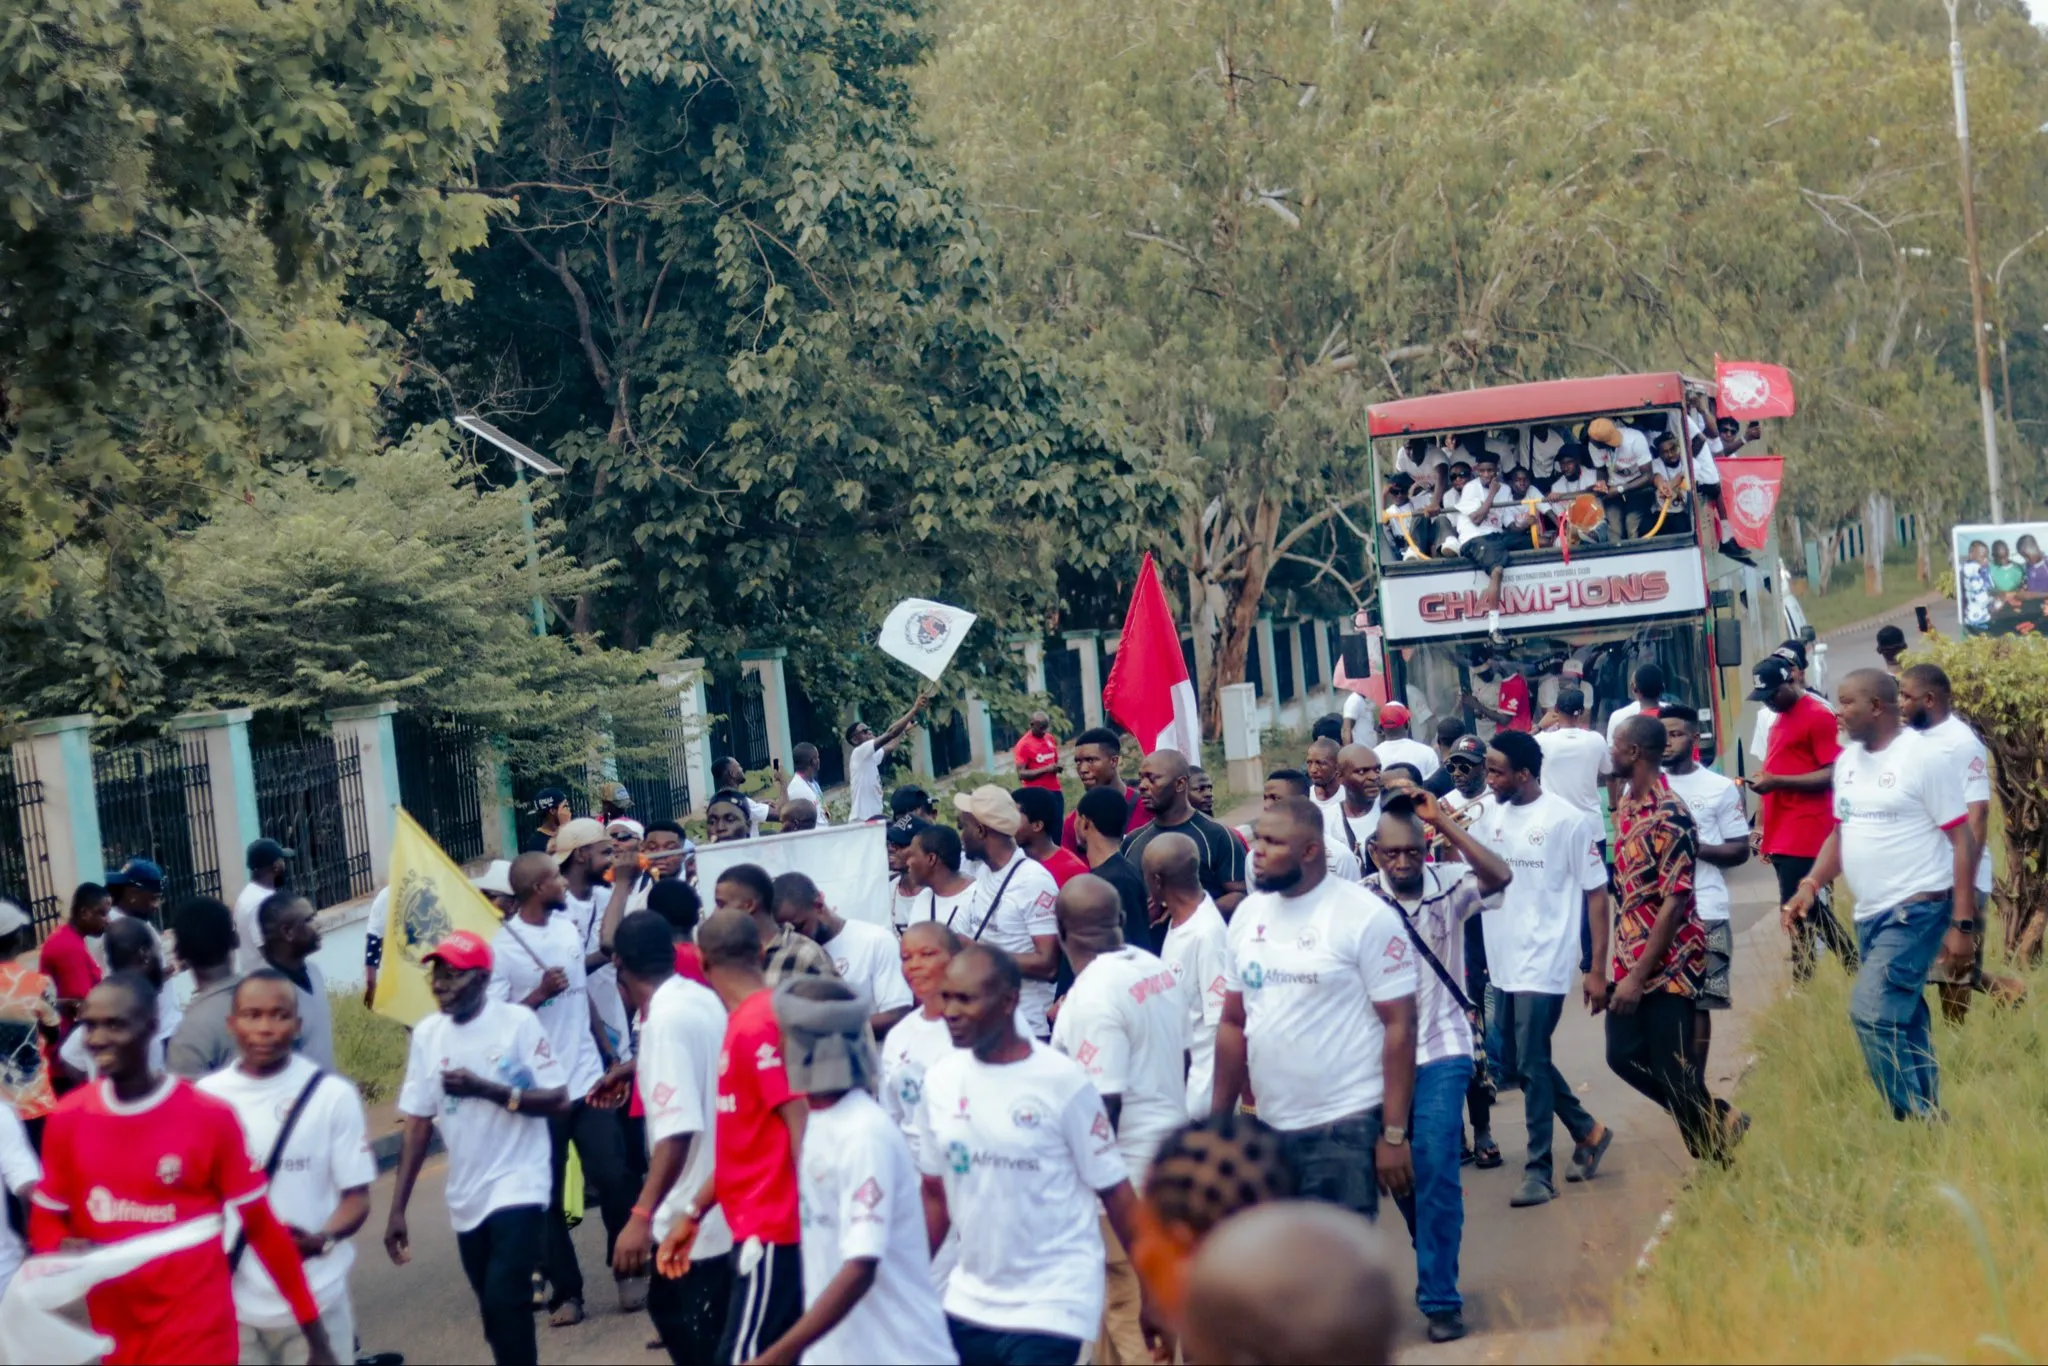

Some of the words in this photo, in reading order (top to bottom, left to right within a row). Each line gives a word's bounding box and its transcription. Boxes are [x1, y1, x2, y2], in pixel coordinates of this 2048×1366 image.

[1418, 570, 1669, 624] CHAMPIONS
[1264, 969, 1320, 985] Afrinvest
[971, 1151, 1040, 1171] Afrinvest
